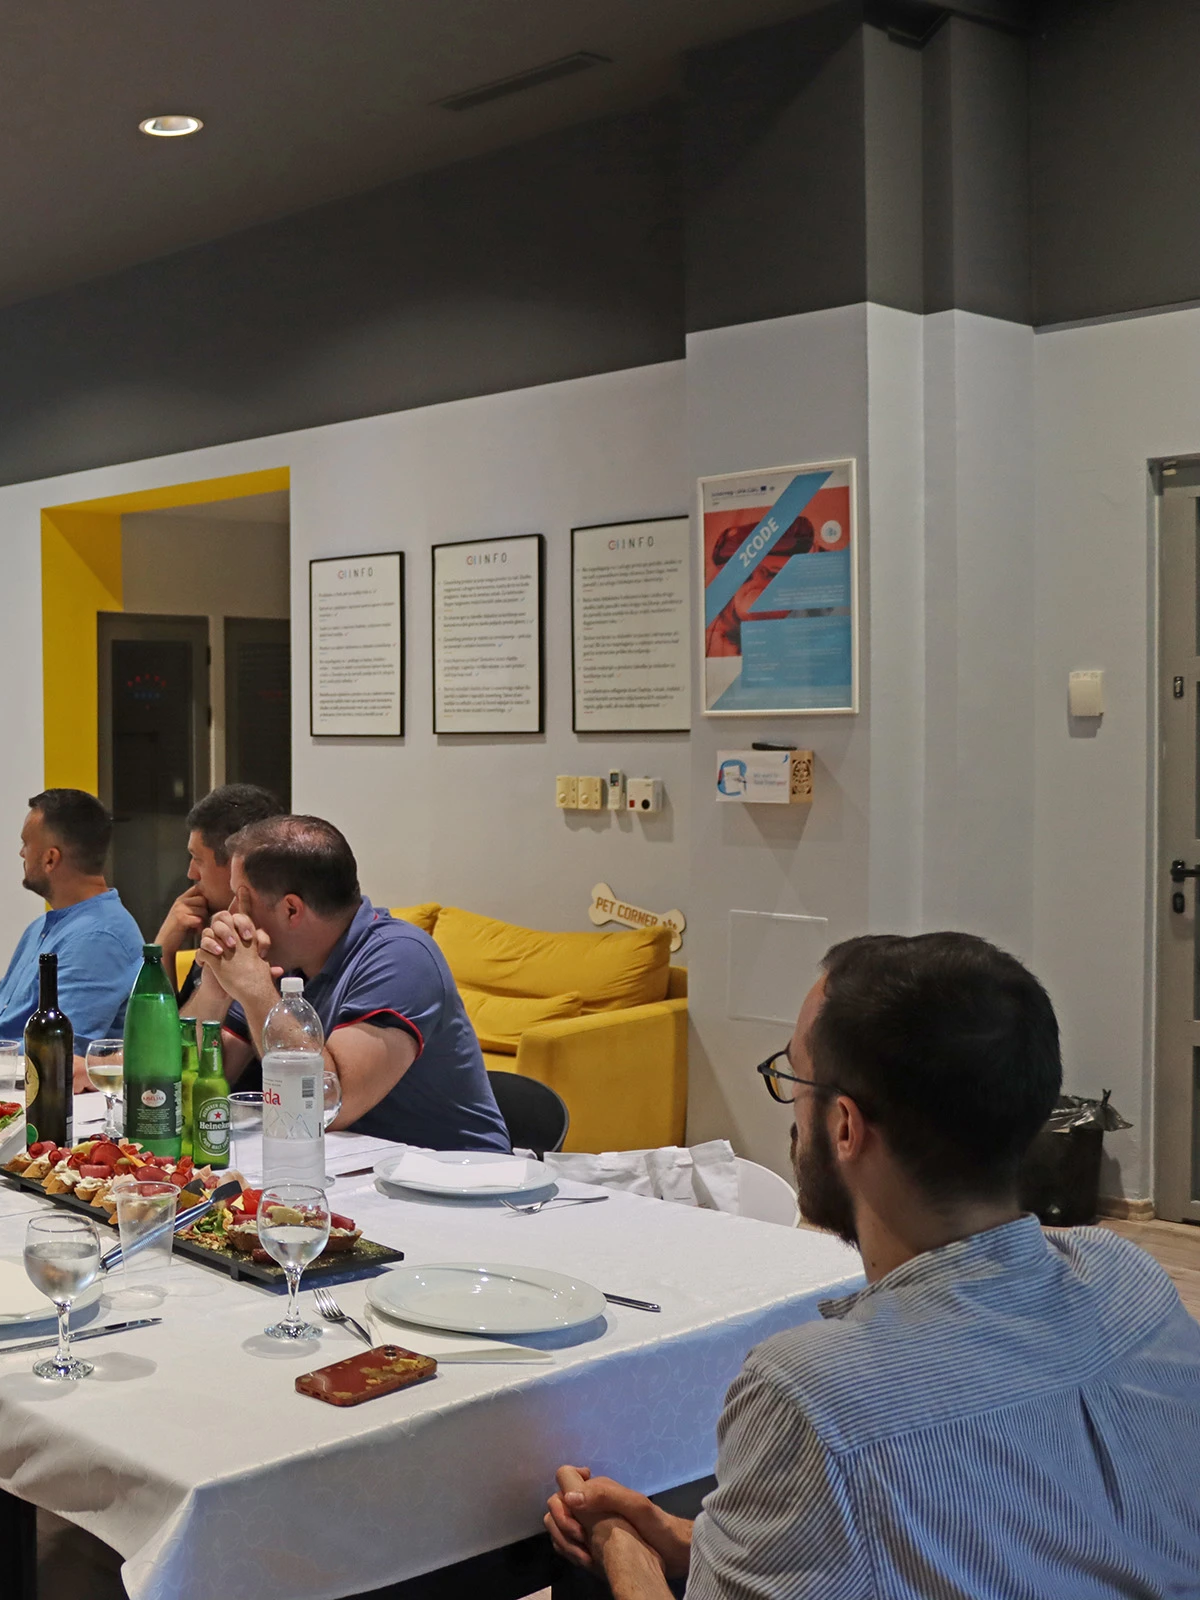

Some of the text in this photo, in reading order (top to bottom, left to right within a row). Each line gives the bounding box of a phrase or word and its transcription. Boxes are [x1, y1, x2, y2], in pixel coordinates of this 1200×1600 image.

[739, 517, 779, 568] 2CODE
[595, 896, 658, 927] PET CORNER
[199, 1121, 230, 1130] Heineke
